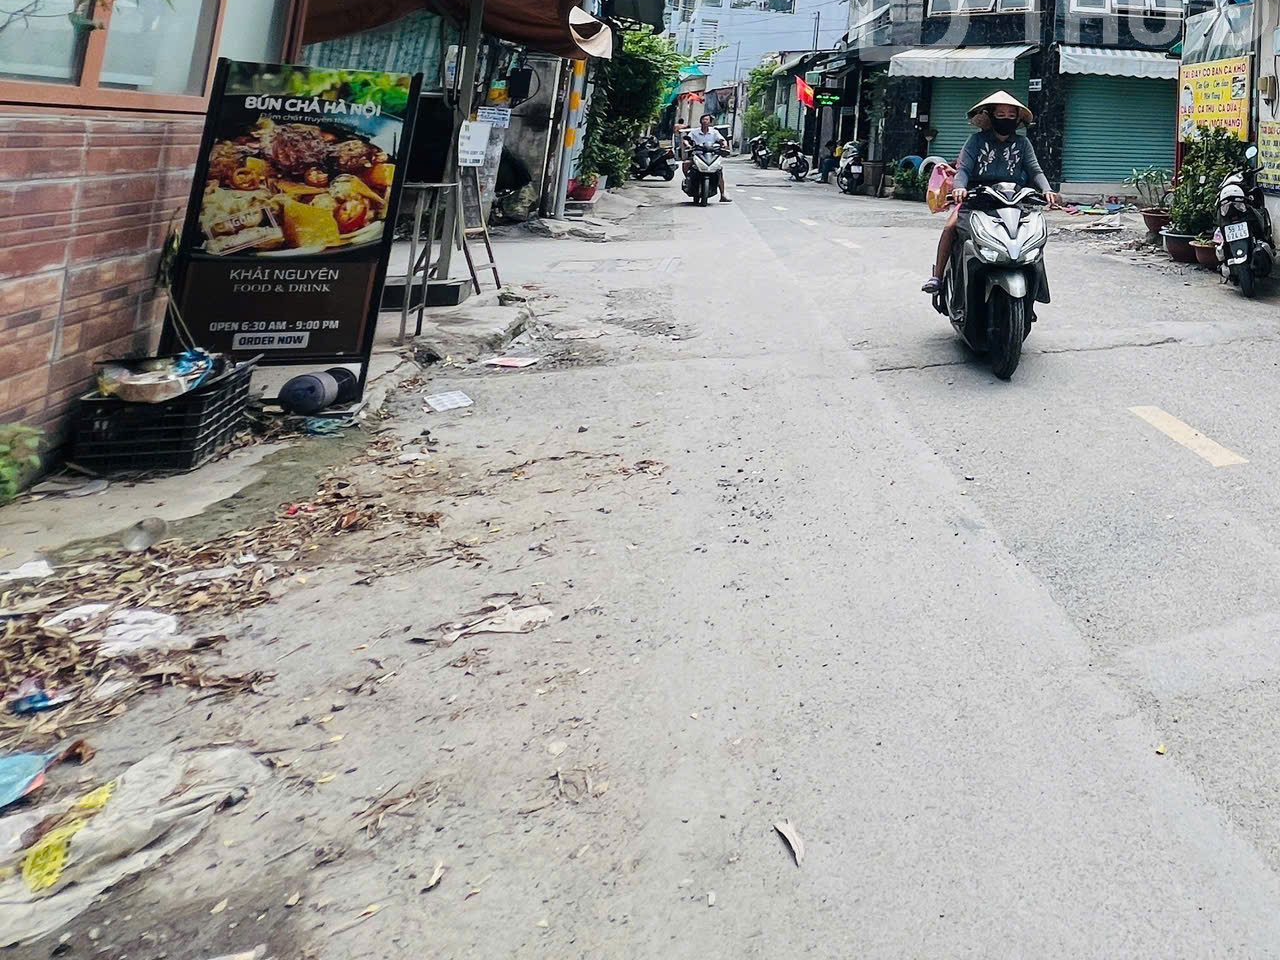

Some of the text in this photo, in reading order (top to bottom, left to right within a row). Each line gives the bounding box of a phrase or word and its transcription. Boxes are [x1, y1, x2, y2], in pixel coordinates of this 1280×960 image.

[244, 94, 381, 118] BÚN CHẢ HÀ NỘI
[273, 267, 339, 280] NGUYÊN
[233, 283, 331, 293] FOOD & DRINK
[209, 321, 238, 332] OPEN
[241, 321, 265, 331] 6:30
[268, 321, 286, 330] AM
[295, 320, 319, 330] 9:00
[322, 320, 339, 329] PM
[239, 334, 304, 346] ORDER NOW
